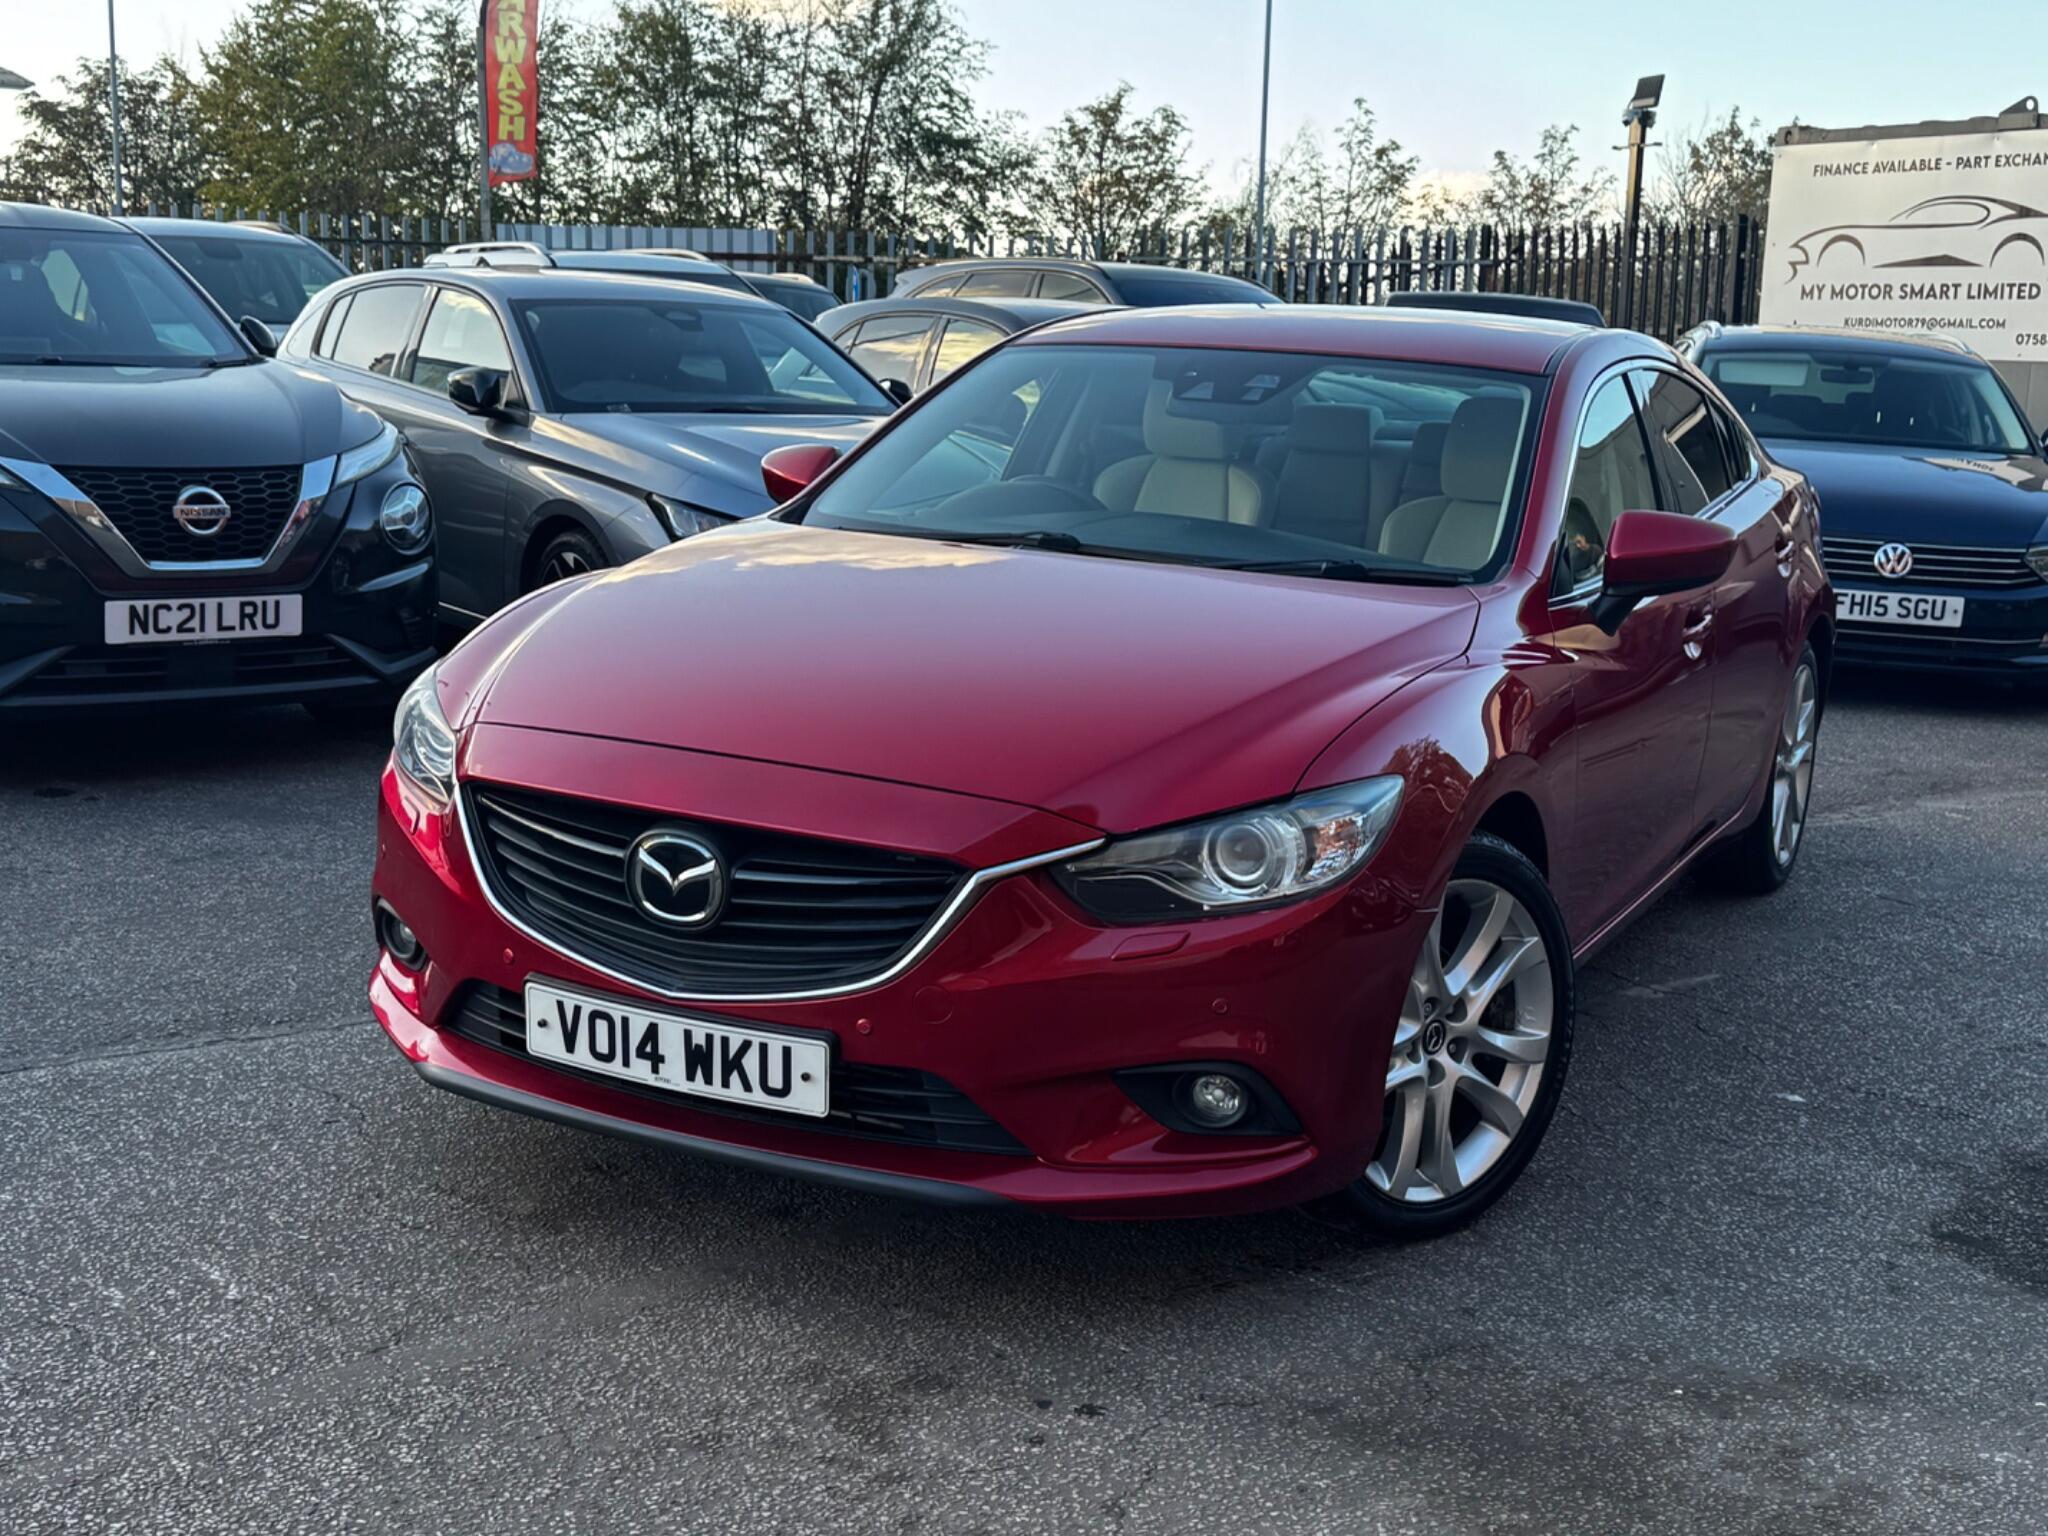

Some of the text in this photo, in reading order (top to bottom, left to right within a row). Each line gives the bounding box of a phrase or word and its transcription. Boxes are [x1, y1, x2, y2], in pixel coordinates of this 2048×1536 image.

[1812, 161, 1869, 177] FINANCE
[1871, 157, 1943, 174] AVAILABLE
[1955, 155, 1992, 170] PART
[1800, 283, 2042, 300] MY MOTOR SMART LIMITED
[1842, 316, 2007, 330] KURDIMOTOR79@GMAIL.COM
[179, 507, 226, 518] NISSAN
[128, 600, 281, 636] NC21 LRU
[1896, 597, 1947, 621] SGU
[556, 999, 793, 1099] VO14 WKU
